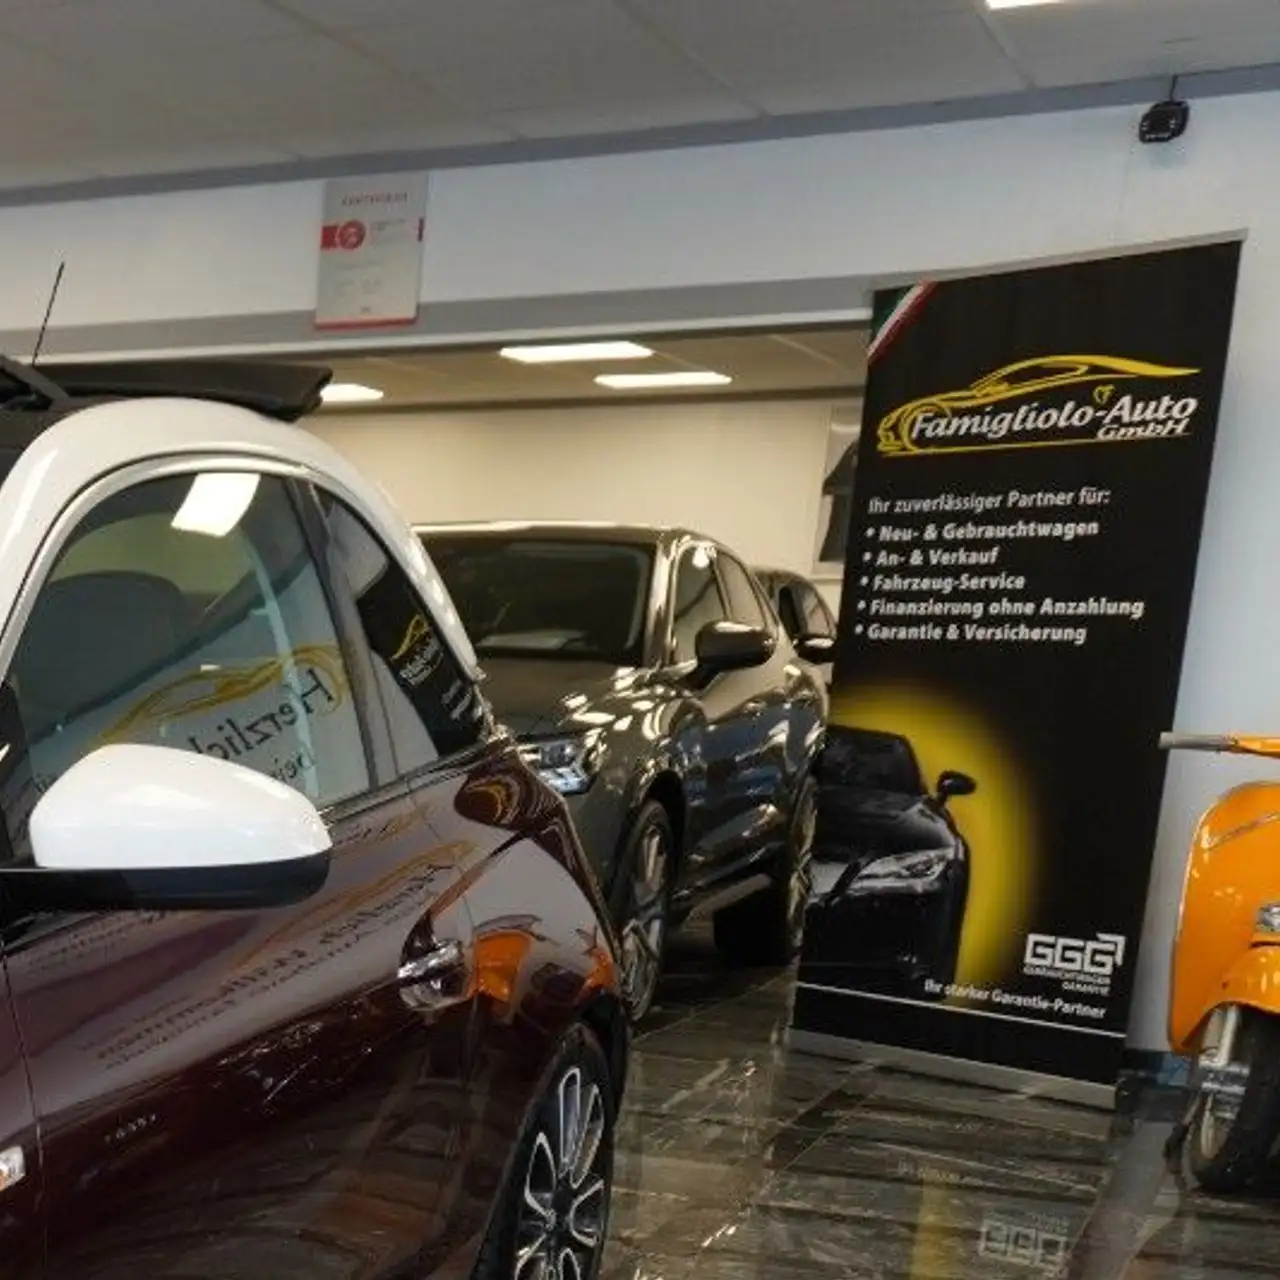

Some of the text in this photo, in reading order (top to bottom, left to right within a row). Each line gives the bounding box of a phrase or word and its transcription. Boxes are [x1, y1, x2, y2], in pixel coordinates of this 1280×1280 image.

[911, 394, 1198, 440] Famigliolo-Auto
[1095, 417, 1190, 441] GmbH
[868, 486, 1111, 515] Ihr zuverlässiger Partner für:
[879, 520, 1100, 542] Neu- & Gebrauchtwagen
[875, 546, 999, 566] An- & Verkauf
[873, 572, 1026, 594] Fahrzeug-Service
[869, 597, 1145, 621] Finanzierung ohne Anzahlung
[867, 623, 1088, 645] Garantie & Versicherung
[1023, 932, 1118, 976] GGG
[991, 988, 1107, 1019] Garantie-Partner
